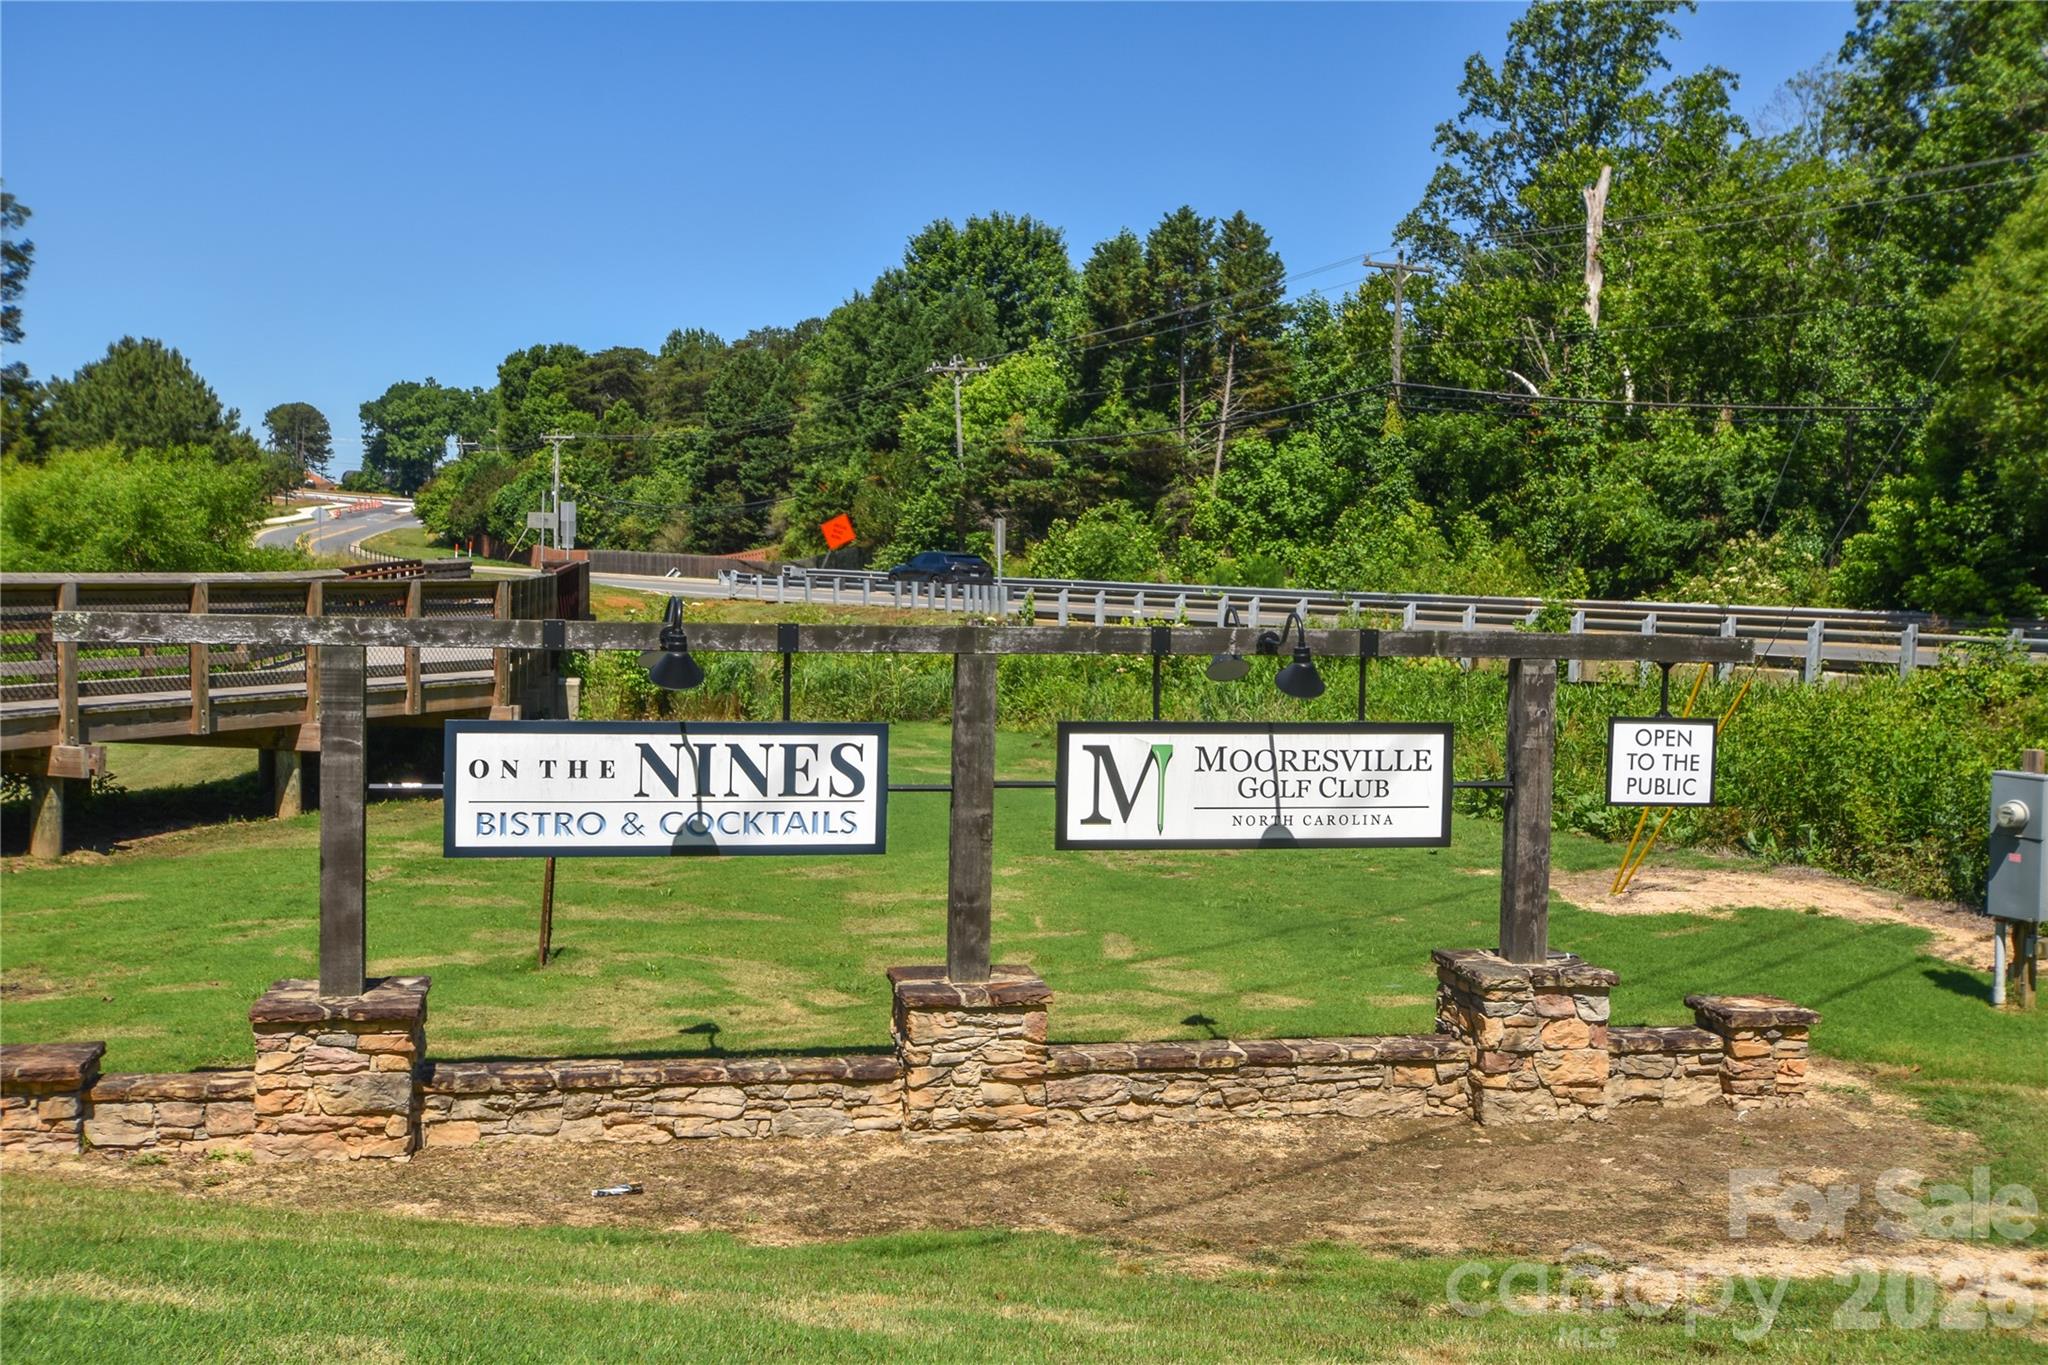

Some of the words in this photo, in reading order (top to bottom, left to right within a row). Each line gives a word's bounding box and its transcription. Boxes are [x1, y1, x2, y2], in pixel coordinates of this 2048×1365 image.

[1635, 728, 1692, 746] OPEN
[468, 758, 519, 779] ON
[539, 759, 616, 779] THE
[634, 742, 866, 797] NINES
[1626, 753, 1655, 770] TO
[1662, 754, 1700, 771] THE
[1626, 777, 1696, 795] PUBLIC
[475, 811, 606, 836] BISTRO
[621, 811, 645, 836] &
[659, 810, 858, 836] COCKTAILS
[1232, 815, 1294, 827] NORTH
[1302, 814, 1394, 827] CAROLINA
